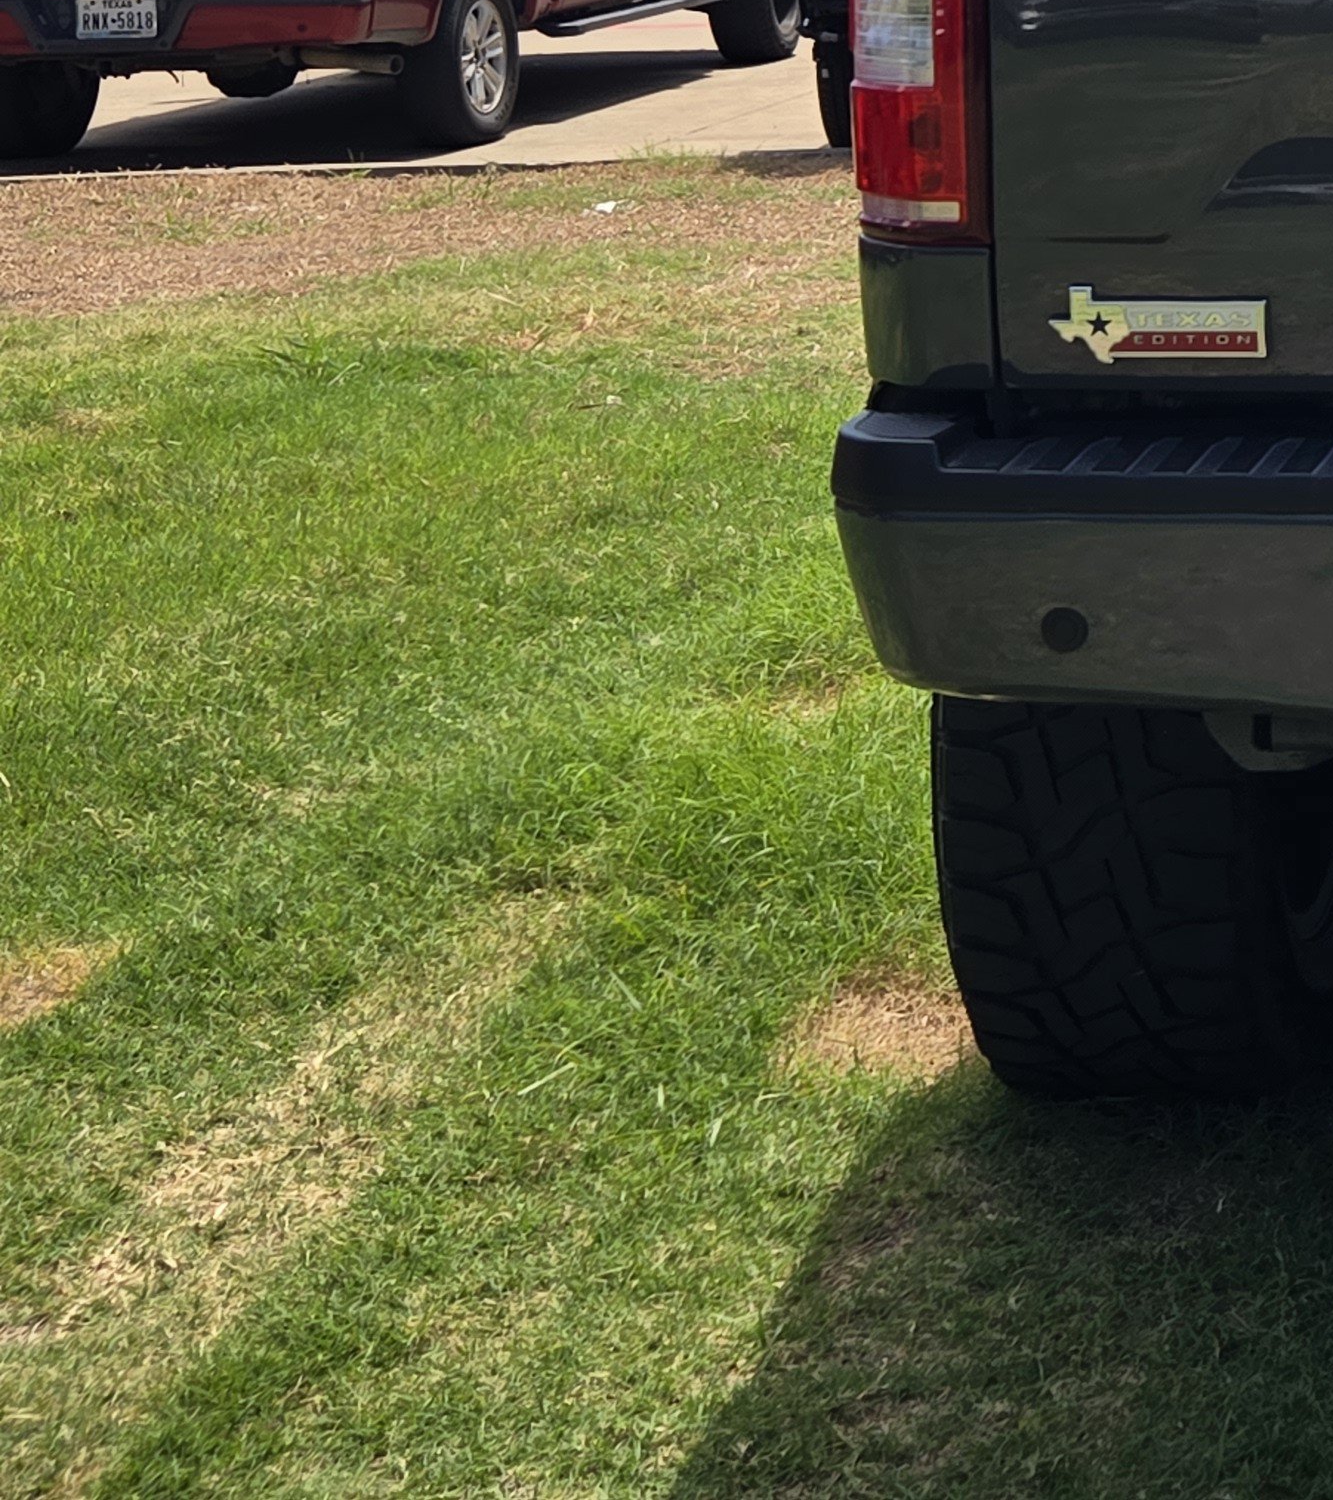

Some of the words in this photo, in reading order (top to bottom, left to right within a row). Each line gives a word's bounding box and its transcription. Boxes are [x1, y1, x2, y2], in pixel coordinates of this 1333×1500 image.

[101, 0, 132, 9] TEXAS
[1131, 311, 1251, 328] TEXAS
[1132, 334, 1251, 345] EDITION
